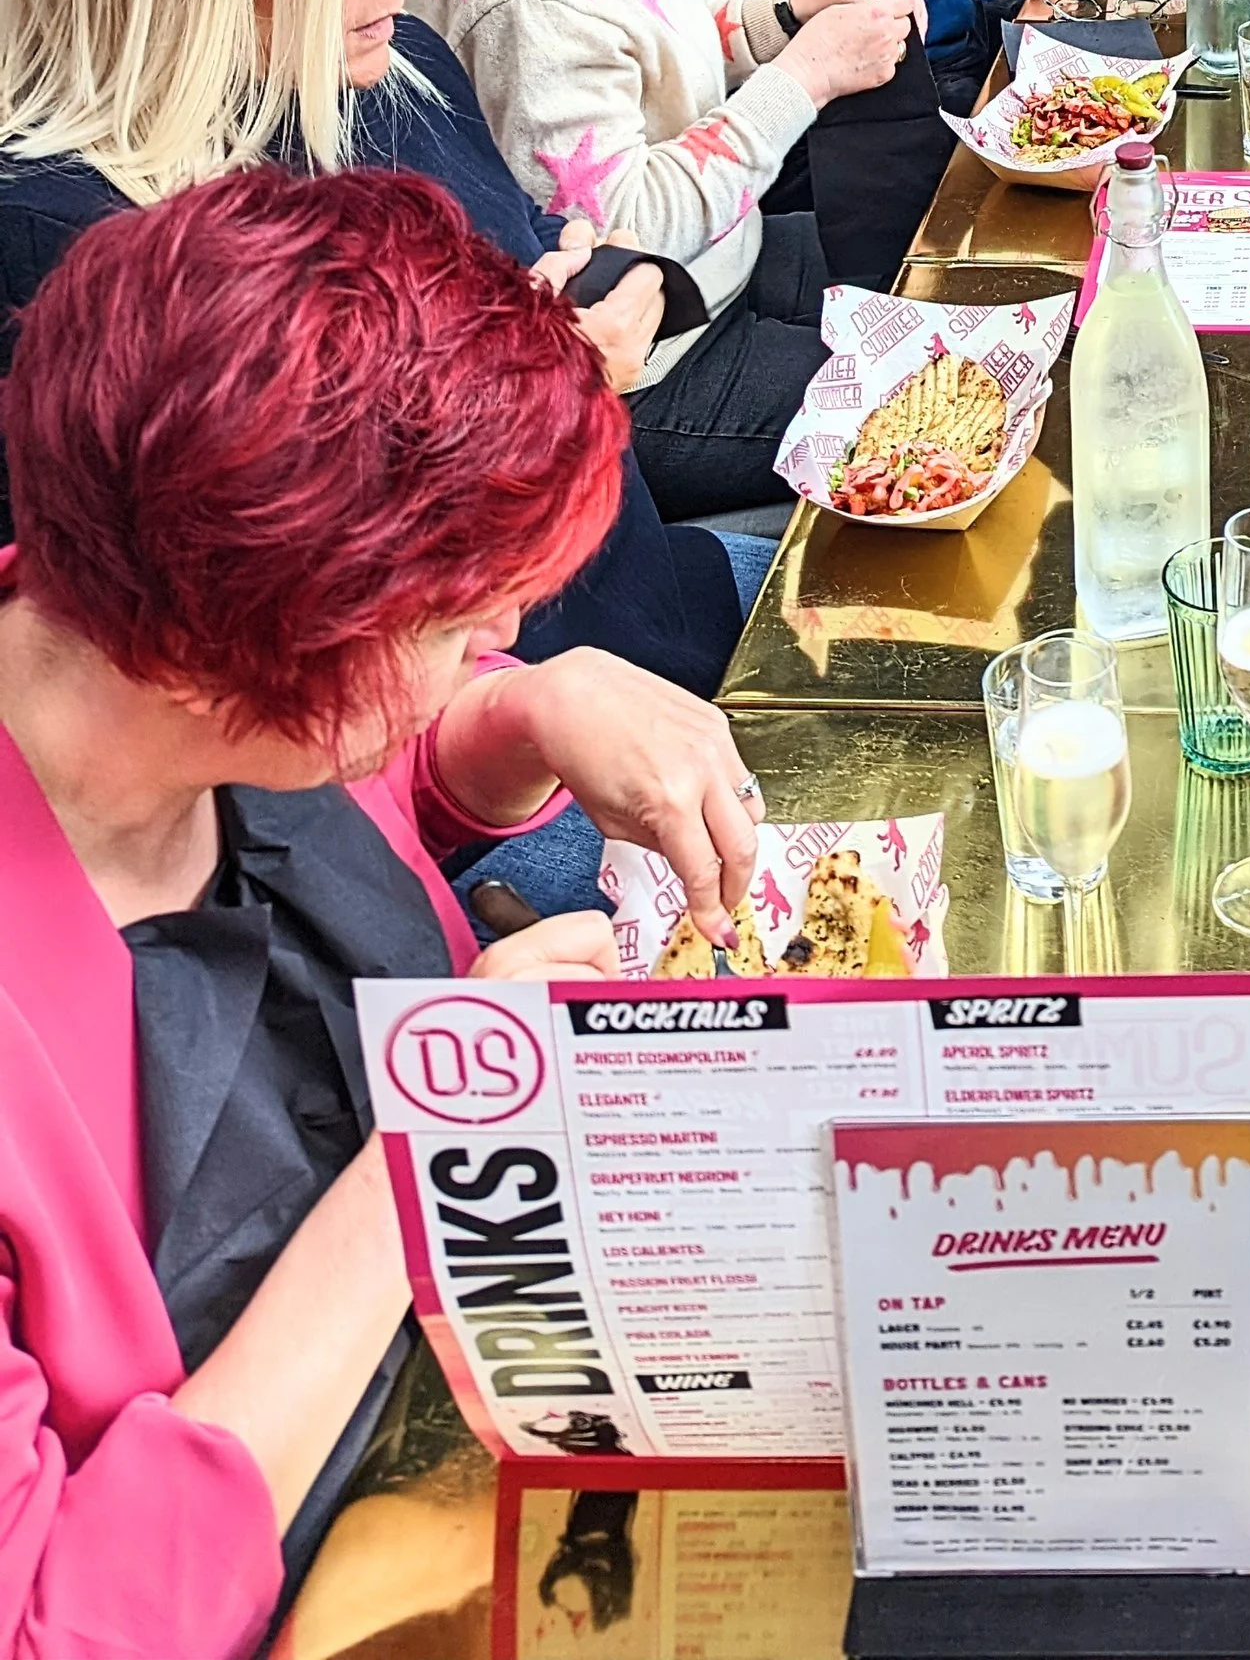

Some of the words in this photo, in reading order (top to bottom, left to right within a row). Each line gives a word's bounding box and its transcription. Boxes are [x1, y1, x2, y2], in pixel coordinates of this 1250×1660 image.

[860, 302, 925, 365] SUMMER
[586, 1000, 768, 1030] COCKTAILS
[945, 997, 1069, 1025] SPRITZ
[574, 1050, 633, 1065] APRICOT
[636, 1050, 747, 1064] COSMOPOLITAN
[942, 1045, 996, 1058] APEROL
[999, 1044, 1049, 1058] SPRITZ
[578, 1093, 647, 1107] ELEGANTE
[944, 1089, 1045, 1103] ELDERFLOWER
[1047, 1088, 1095, 1101] SPRITZ
[585, 1132, 657, 1147] ESPRESSO
[660, 1131, 718, 1145] MARTINI
[589, 1172, 675, 1187] GRAPEFRUIT
[678, 1170, 740, 1185] NEGRONI
[598, 1211, 624, 1223] HEY
[931, 1227, 1058, 1257] DRINKS
[1061, 1221, 1168, 1251] MENU
[603, 1246, 629, 1258] LOS
[631, 1244, 705, 1258] CALIENTES
[429, 1145, 614, 1398] DRINKS
[878, 1298, 904, 1311] ON
[911, 1296, 946, 1310] TAP
[878, 1324, 920, 1334] LAGER
[880, 1341, 920, 1350] HOUSE
[924, 1340, 961, 1350] PARTY
[653, 1373, 735, 1391] WINE
[883, 1376, 968, 1391] BOTTLES
[976, 1376, 990, 1389] &
[998, 1375, 1048, 1389] CANS
